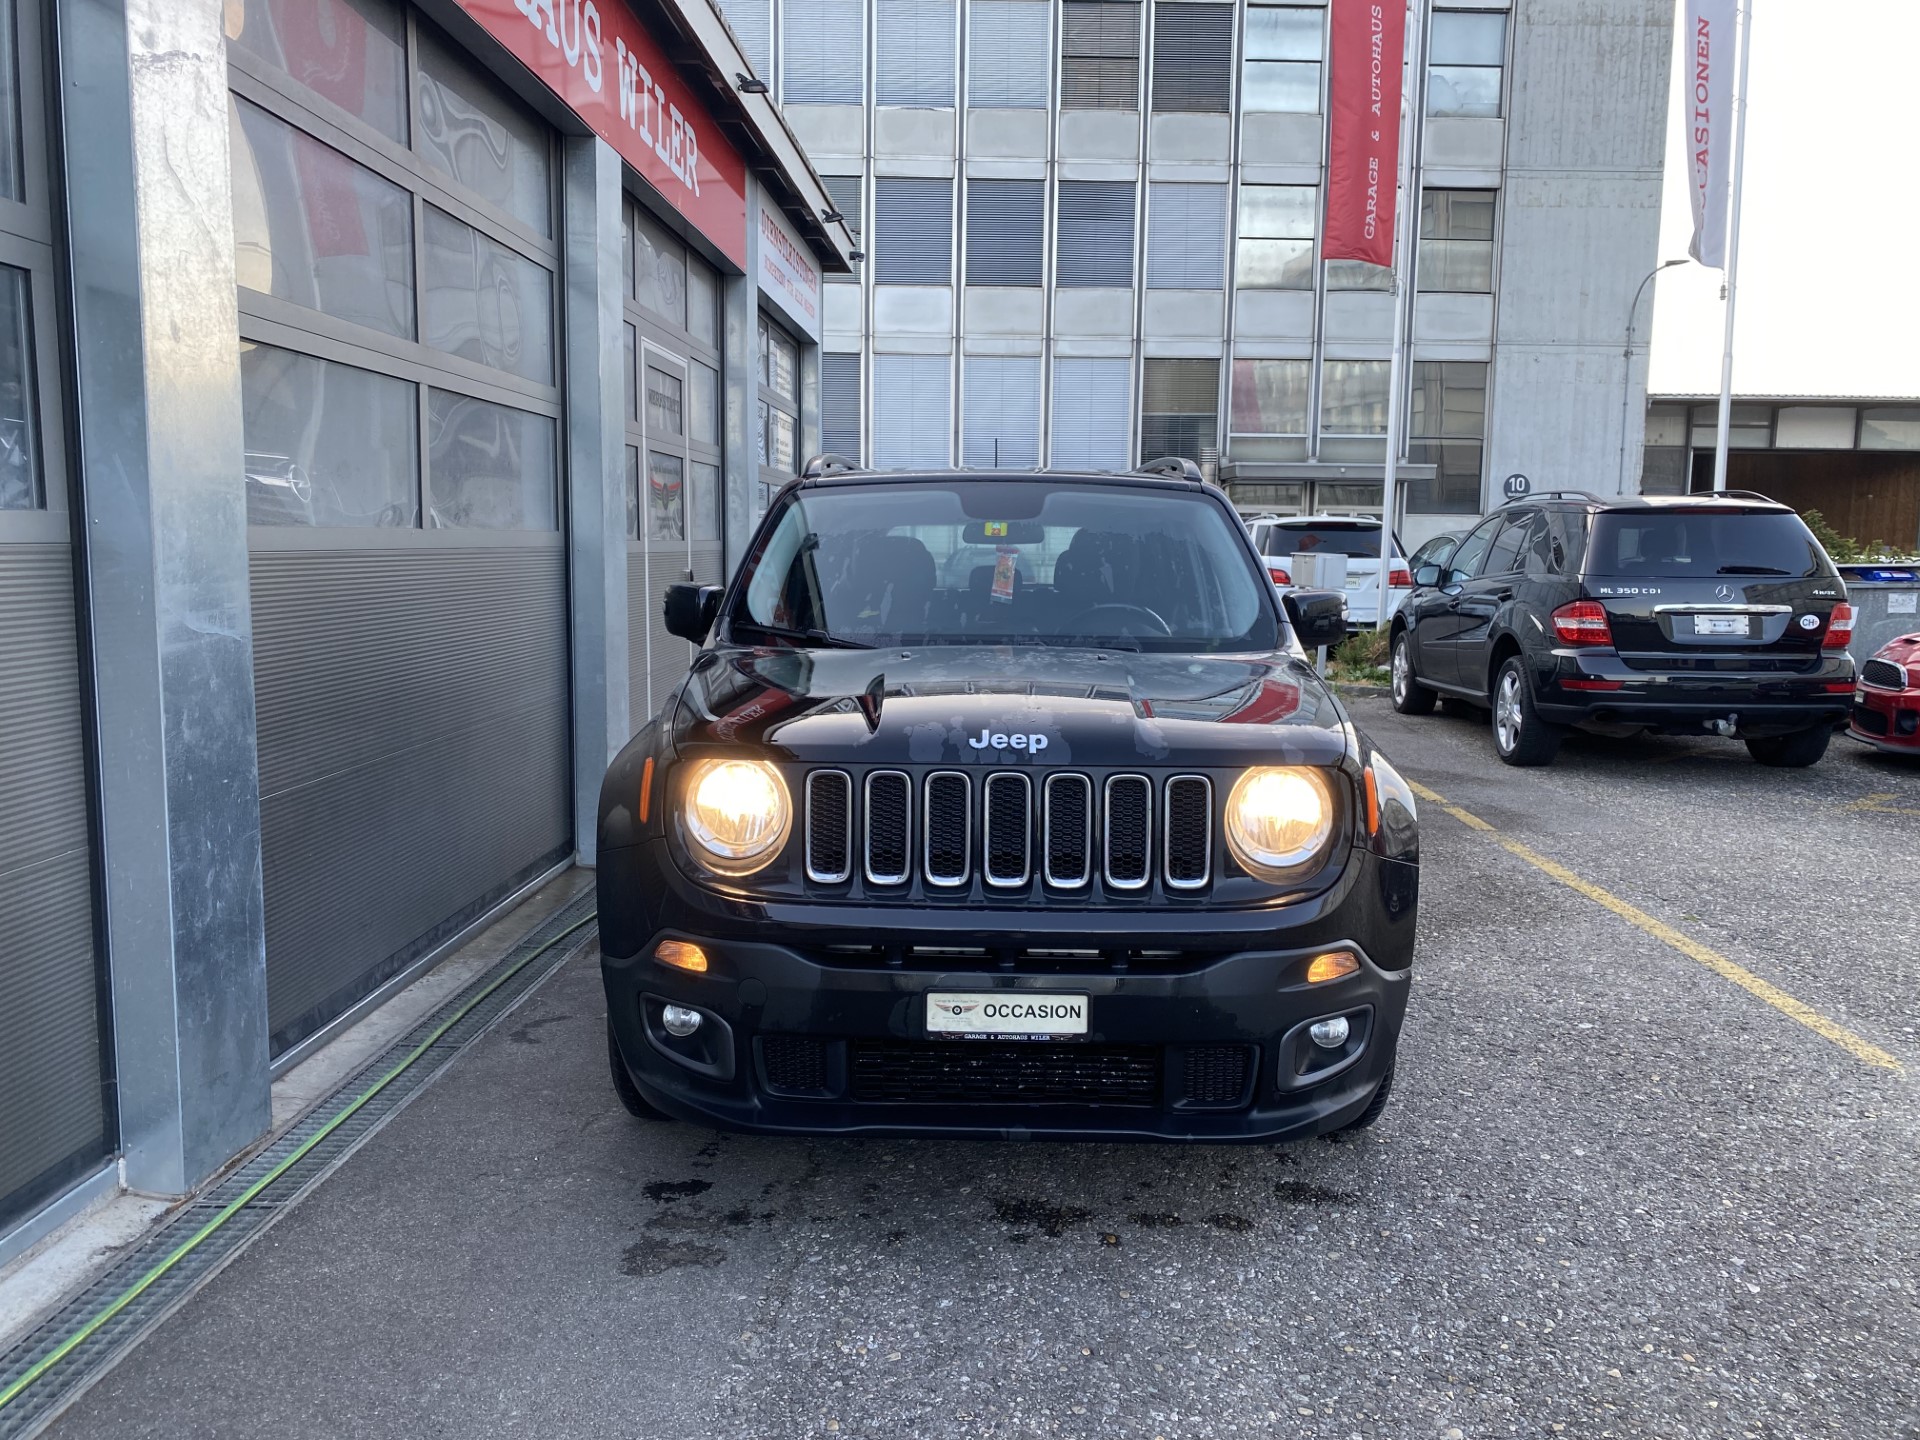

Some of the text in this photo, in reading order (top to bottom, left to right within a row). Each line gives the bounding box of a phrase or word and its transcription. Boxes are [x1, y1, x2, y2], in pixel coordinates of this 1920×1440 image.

[514, 0, 700, 198] AUS WILER
[1364, 5, 1383, 240] GARAGE & AUTOHAUS
[1509, 477, 1525, 491] 10
[1802, 618, 1815, 627] CH
[968, 729, 1048, 754] Jeep
[983, 1003, 1082, 1019] OCCASION
